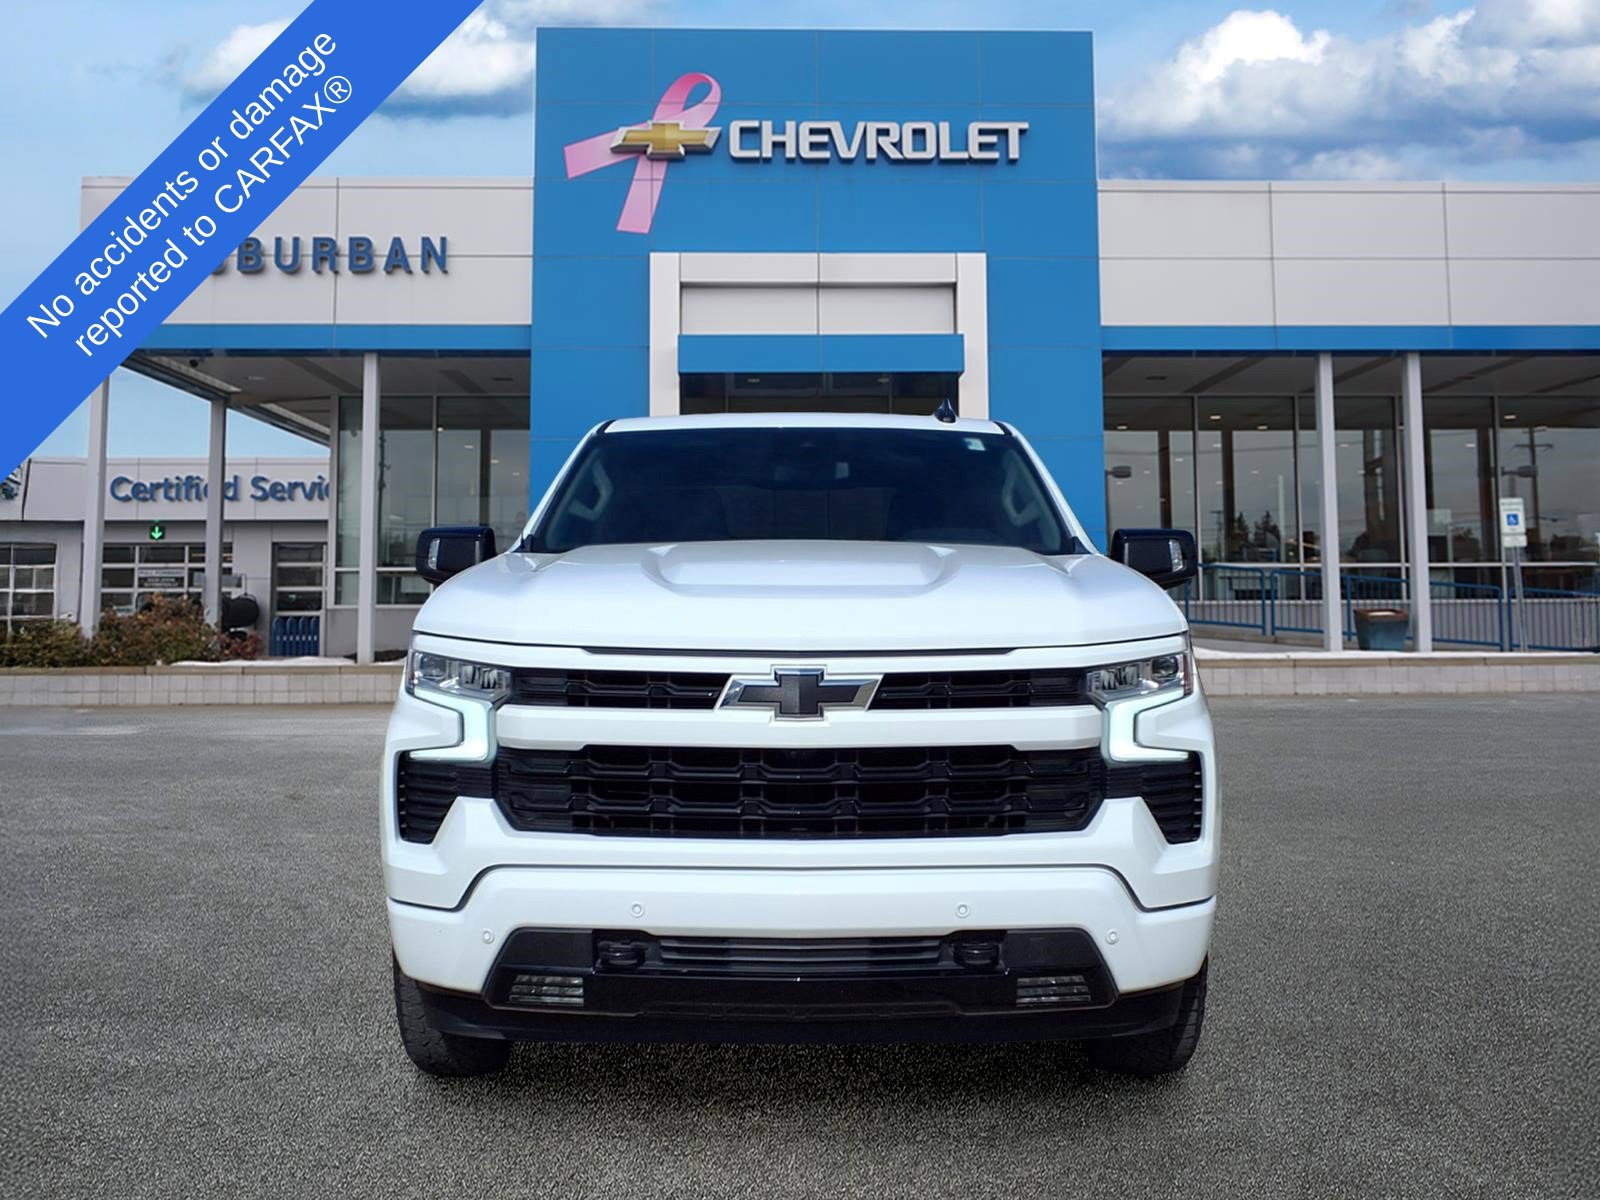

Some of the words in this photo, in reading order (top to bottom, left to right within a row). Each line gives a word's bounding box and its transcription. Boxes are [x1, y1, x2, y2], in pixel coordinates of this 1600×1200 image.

[729, 120, 1029, 160] CHEVROLET
[212, 236, 449, 274] BURBAN
[110, 475, 239, 501] Certifid
